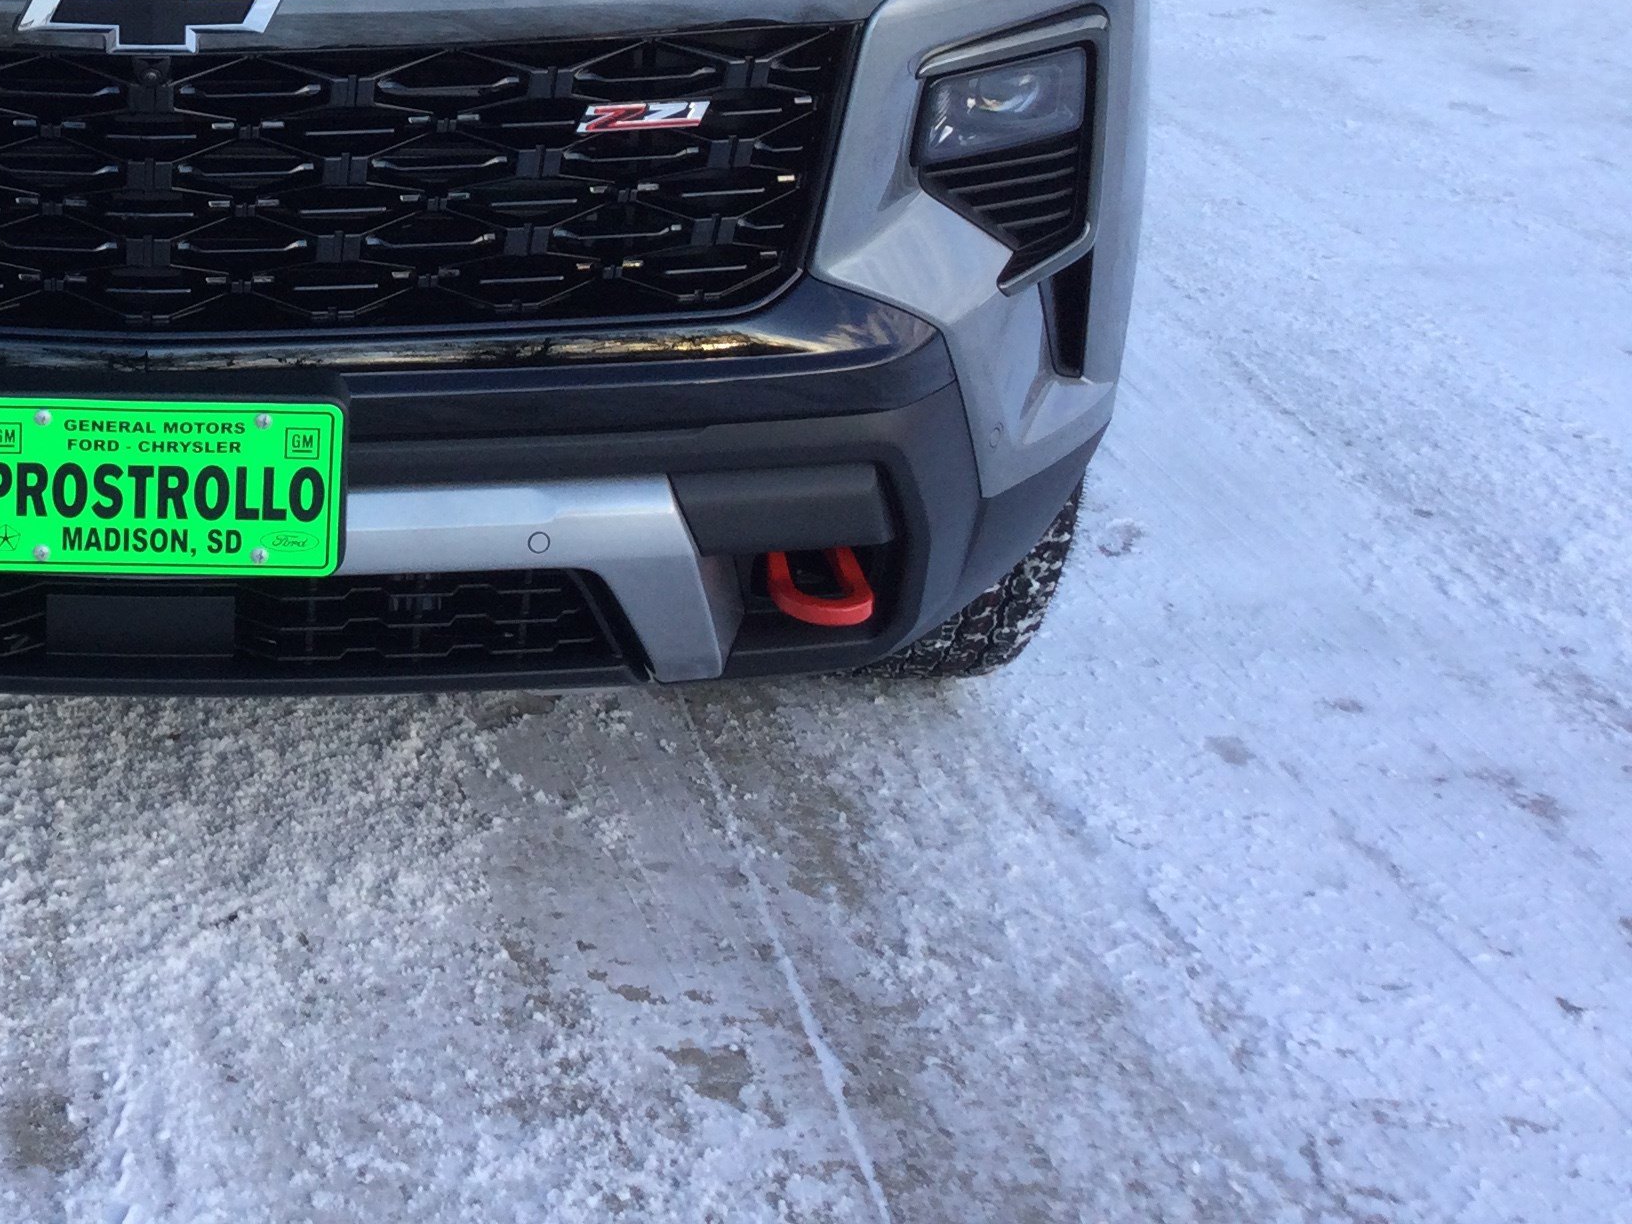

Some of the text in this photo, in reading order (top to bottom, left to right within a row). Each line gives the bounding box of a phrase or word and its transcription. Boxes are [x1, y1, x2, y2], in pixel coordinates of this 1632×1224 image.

[576, 101, 710, 132] Z71
[63, 419, 246, 435] GENERAL MOTORS
[67, 439, 120, 452] FORD
[138, 441, 242, 454] CHRYSLER
[291, 434, 314, 448] GM
[61, 527, 242, 558] MADISON, SD
[271, 534, 309, 547] Ford
